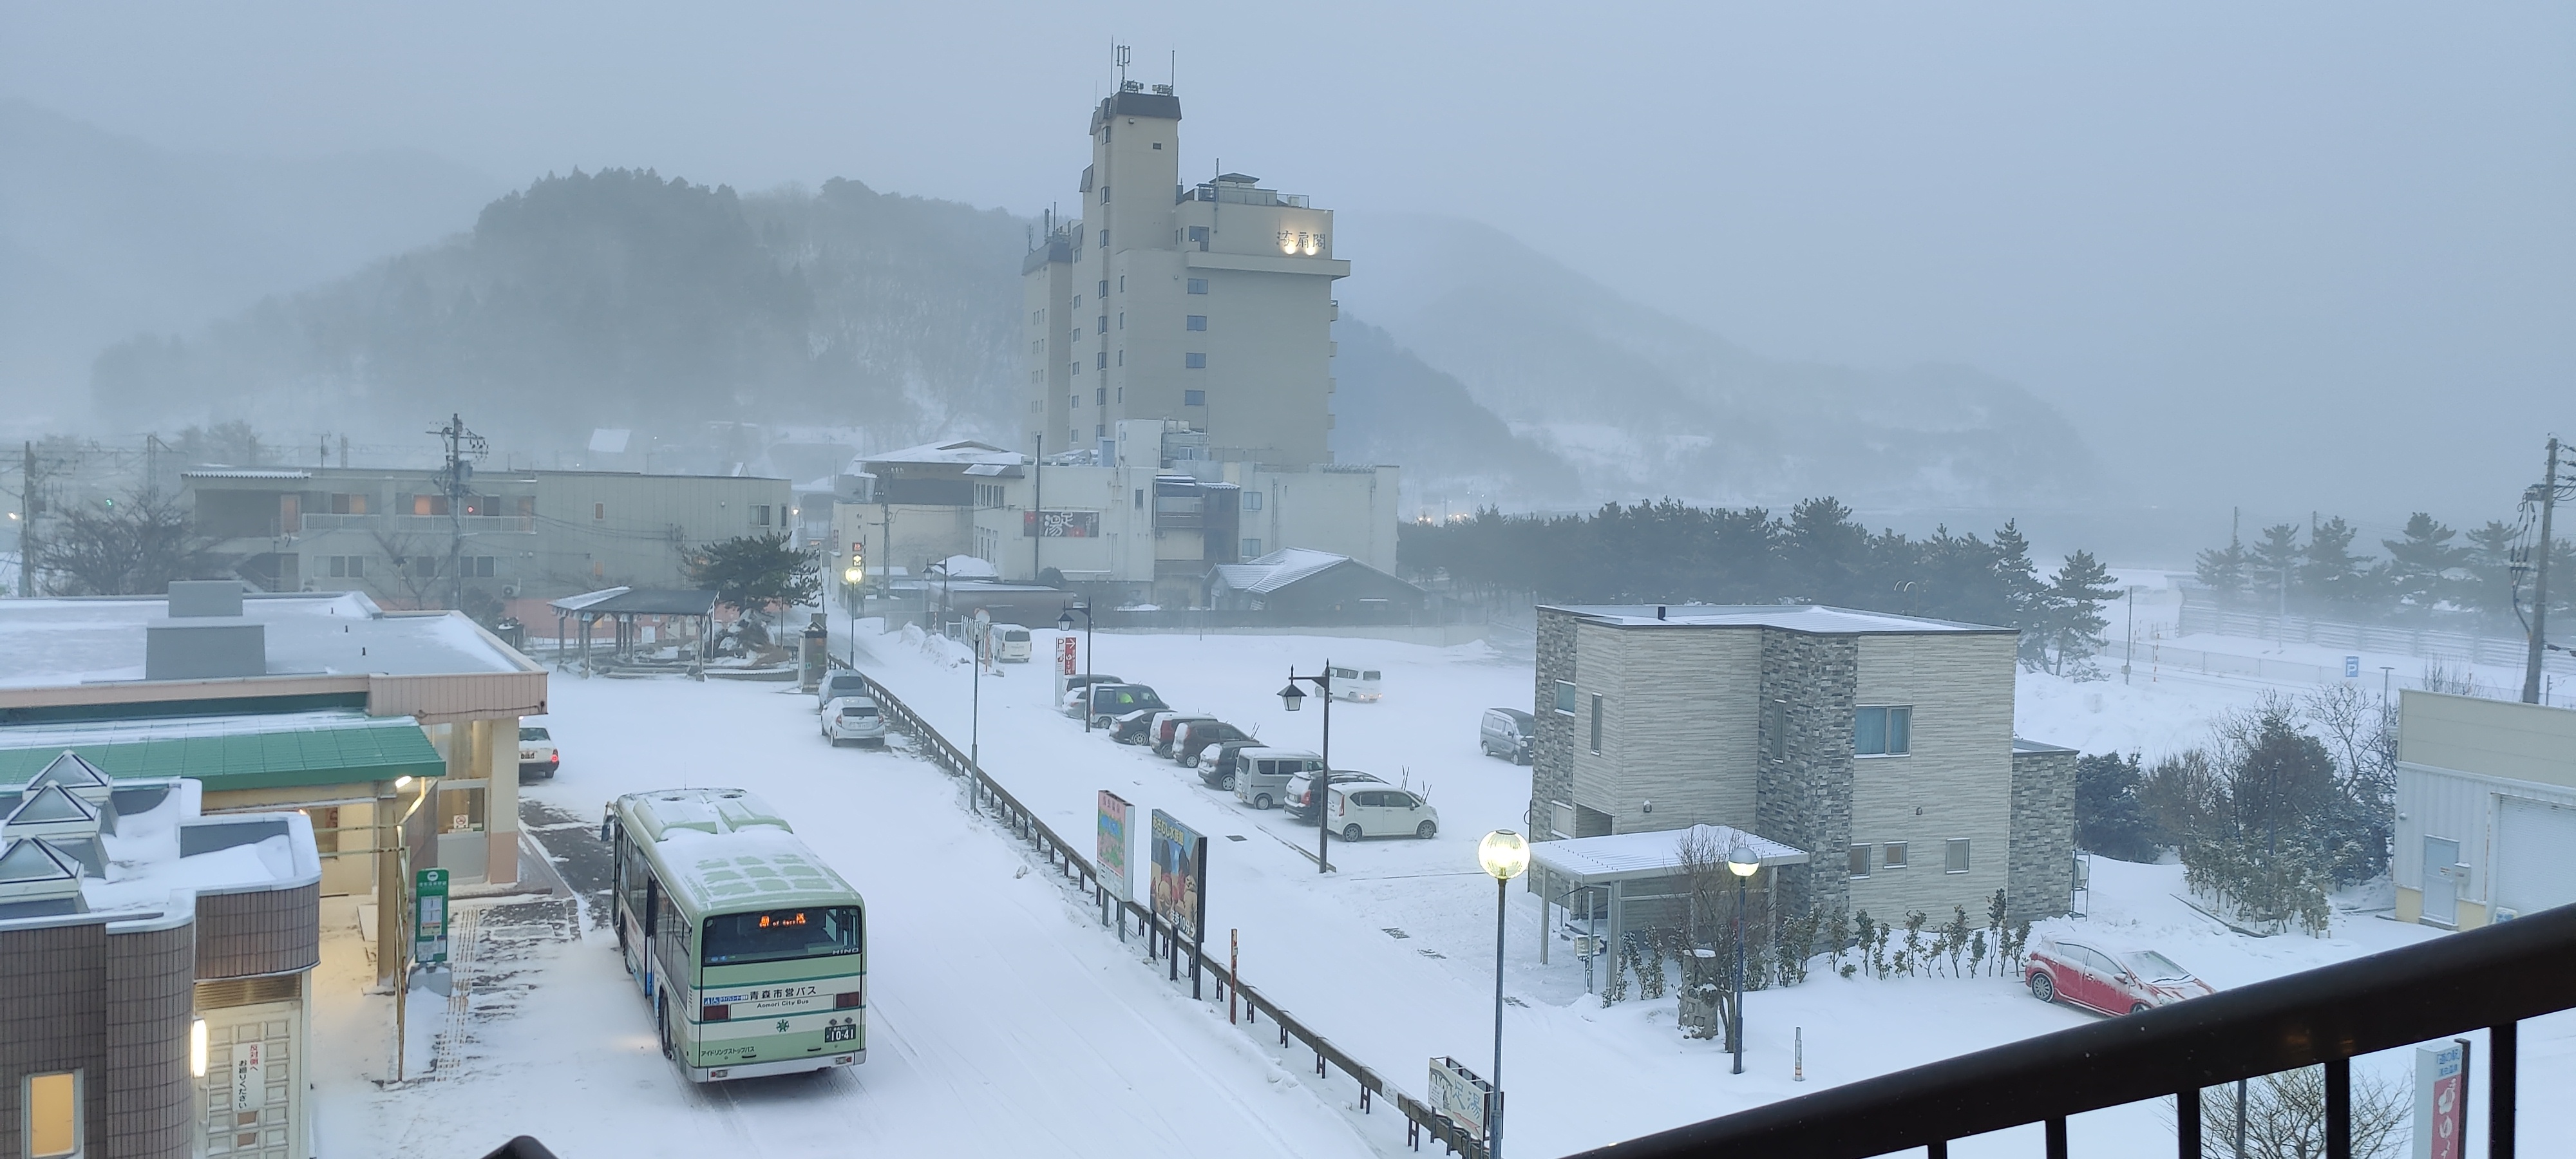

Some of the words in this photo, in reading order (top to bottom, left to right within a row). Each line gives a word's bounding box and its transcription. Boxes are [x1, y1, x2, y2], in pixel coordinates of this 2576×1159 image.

[1276, 231, 1326, 250] 海扇閣
[1057, 638, 1065, 649] P
[2347, 664, 2357, 676] P
[1153, 814, 1184, 847] あさむし水族館
[1170, 908, 1190, 934] 徒歩10分
[750, 986, 817, 1001] 青森市営バス
[701, 1046, 755, 1057] アイドリングストップバス
